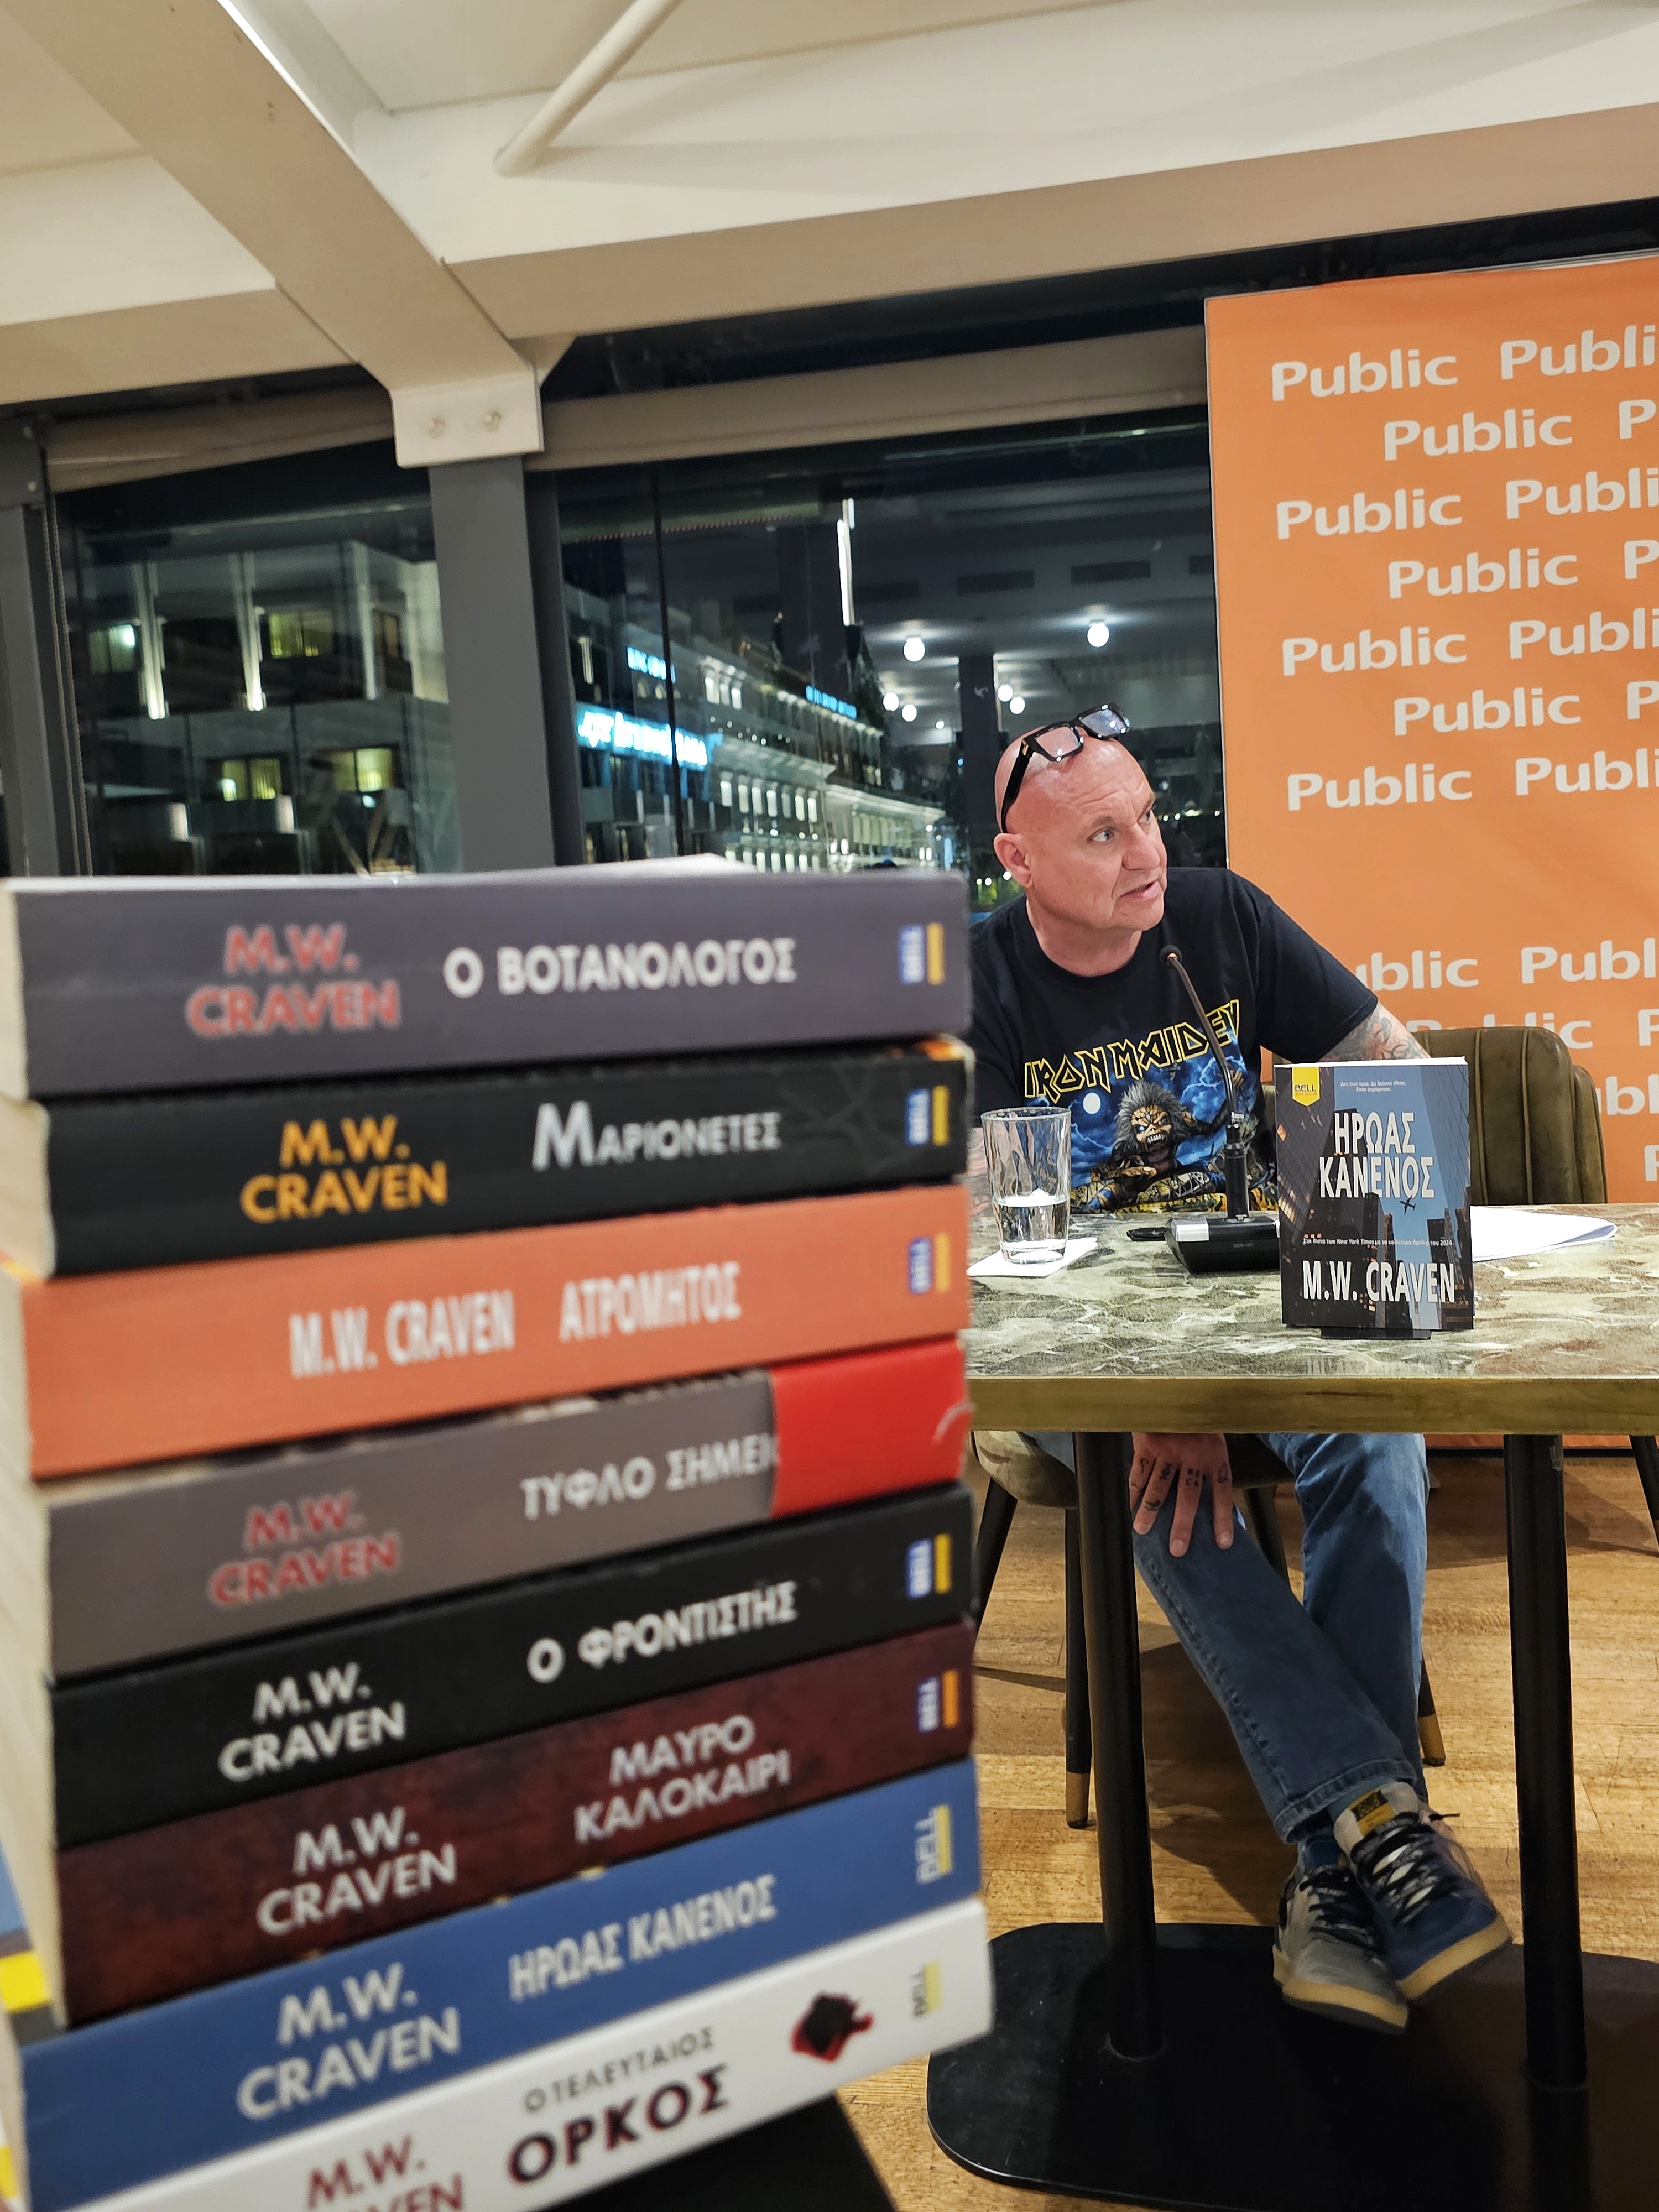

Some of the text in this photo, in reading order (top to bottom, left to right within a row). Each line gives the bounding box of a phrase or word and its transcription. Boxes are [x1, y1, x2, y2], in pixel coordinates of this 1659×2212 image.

[1272, 325, 1655, 401] Public Publi
[1385, 409, 1572, 460] Public
[1277, 468, 1659, 539] Public Publi
[1389, 549, 1577, 598] Public
[1282, 608, 1659, 676] Public Publi
[1395, 688, 1580, 735] Public
[1288, 749, 1659, 811] Public Publ
[223, 922, 360, 977] M.W.
[444, 937, 798, 998] Ο ΒΟΤΑΝΟΛΟΓΟΣ
[1521, 938, 1656, 983] Publ
[186, 978, 401, 1038] CRAVEN
[1024, 1046, 1112, 1104] IRON
[280, 1114, 410, 1168] M.W.
[1334, 1112, 1415, 1154] ΗΡΩΑΣ
[240, 1160, 447, 1225] CRAVEN
[1319, 1156, 1434, 1198] ΚΑΝΕΝΟΣ
[1302, 1260, 1455, 1303] M.W. CRAVEN
[289, 1261, 741, 1379] M.W. CRAVEN ΑΤΡΟΜΗΤΟΣ
[246, 1489, 367, 1550] M.W.
[520, 1456, 656, 1521] ΤΥΦΛΟ
[208, 1530, 400, 1606] CRAVEN
[528, 1580, 797, 1683] Ο ΦΡΟΝΤΙΣΤΗΣ
[252, 1662, 373, 1724] M.W.
[218, 1702, 406, 1782] CRAVEN
[611, 1714, 755, 1783] ΜΑΥΡΟ
[573, 1750, 791, 1843] ΚΑΛΟΚΑΙΡΙ
[293, 1806, 420, 1876] M.W.
[257, 1843, 456, 1937] CRAVEN
[509, 1873, 777, 2003] ΗΡΩΑΣ ΚΑΝΕΝΟΣ
[278, 1961, 418, 2046] M.W.
[237, 2007, 461, 2121] CRAVEN
[523, 2026, 714, 2112] Ο ΤΕΛΕΥΤΑΙΟΣ
[507, 2063, 728, 2184] ΟΡΚΟΣ
[307, 2133, 427, 2210] M.W.
